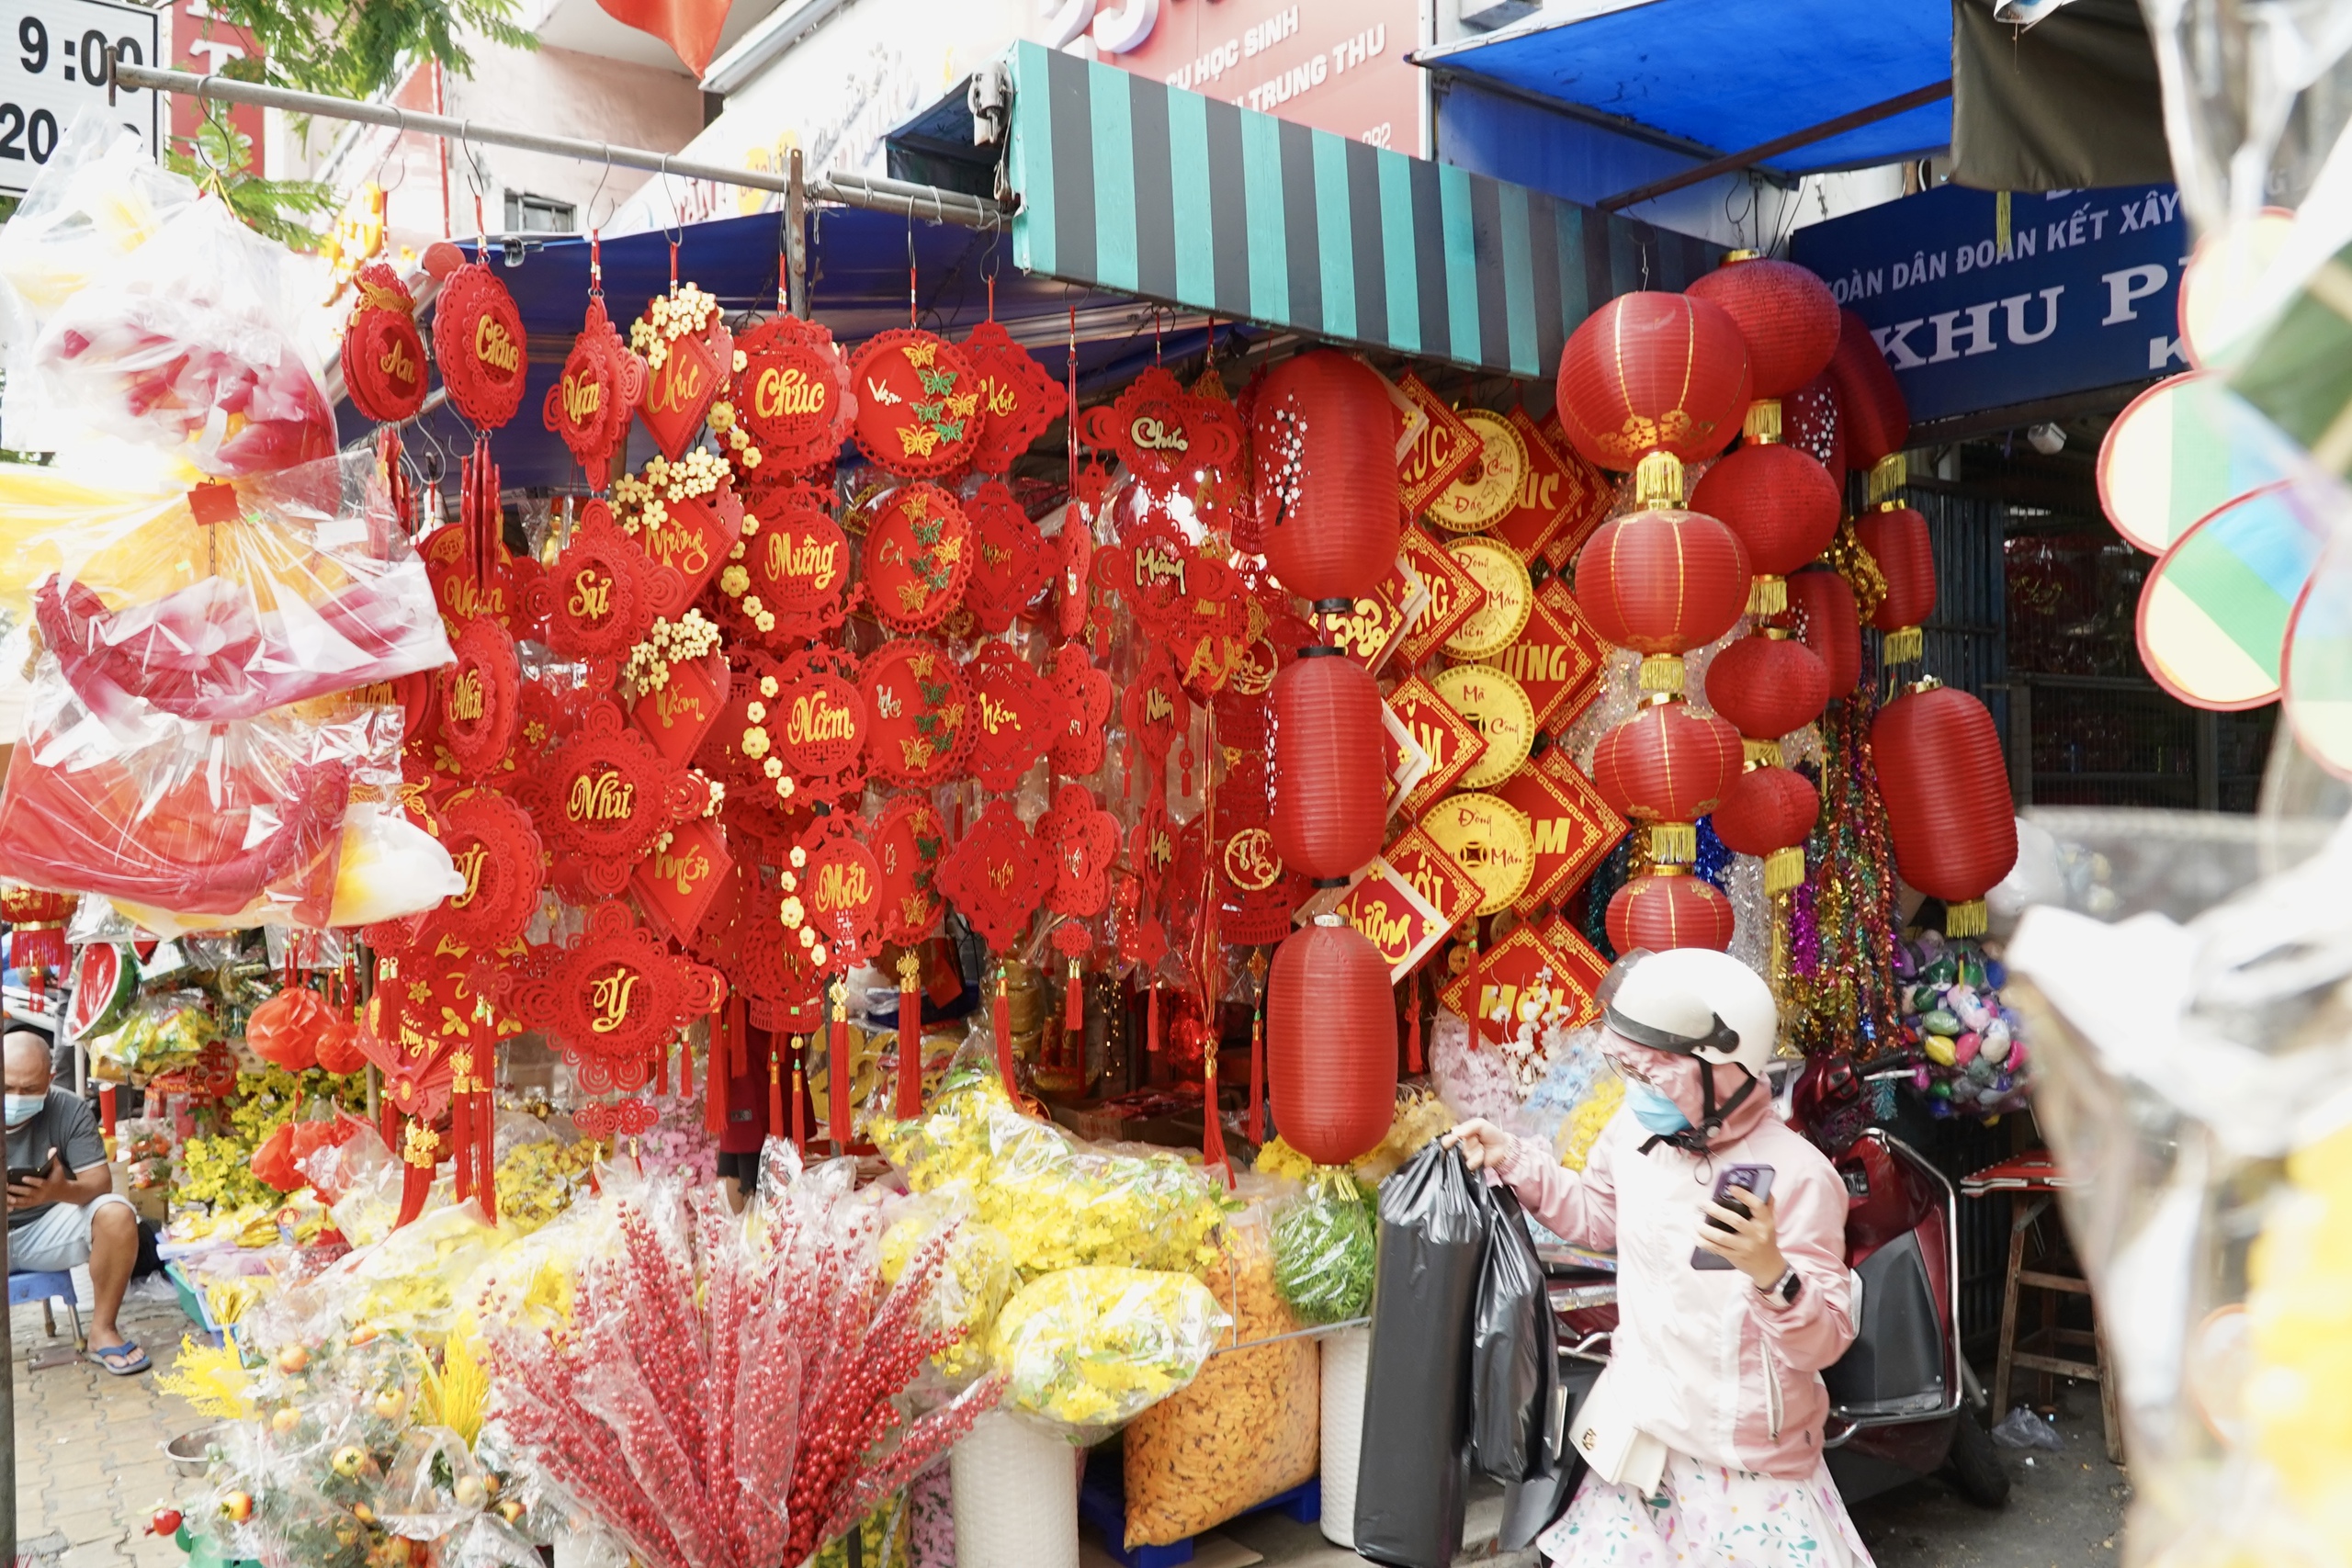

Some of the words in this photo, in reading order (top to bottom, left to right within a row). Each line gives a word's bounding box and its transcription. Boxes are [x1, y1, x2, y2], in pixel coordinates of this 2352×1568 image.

[1194, 39, 1239, 82] HỌC
[1244, 6, 1300, 58] SINH
[1248, 54, 1328, 112] TRUNG
[1332, 23, 1386, 73] THU
[1826, 267, 1883, 305] OÀN
[1893, 250, 1948, 290] DÂN
[2047, 201, 2109, 253] KẾT
[2119, 189, 2180, 235] XÂY
[1870, 285, 2065, 370] KHU
[754, 367, 825, 422] Chúc
[1130, 416, 1189, 452] Chúc
[763, 532, 840, 591] Mừng
[786, 689, 855, 746] Năm
[566, 771, 634, 822] Như
[814, 860, 873, 914] Mới
[591, 967, 640, 1033] Ý
